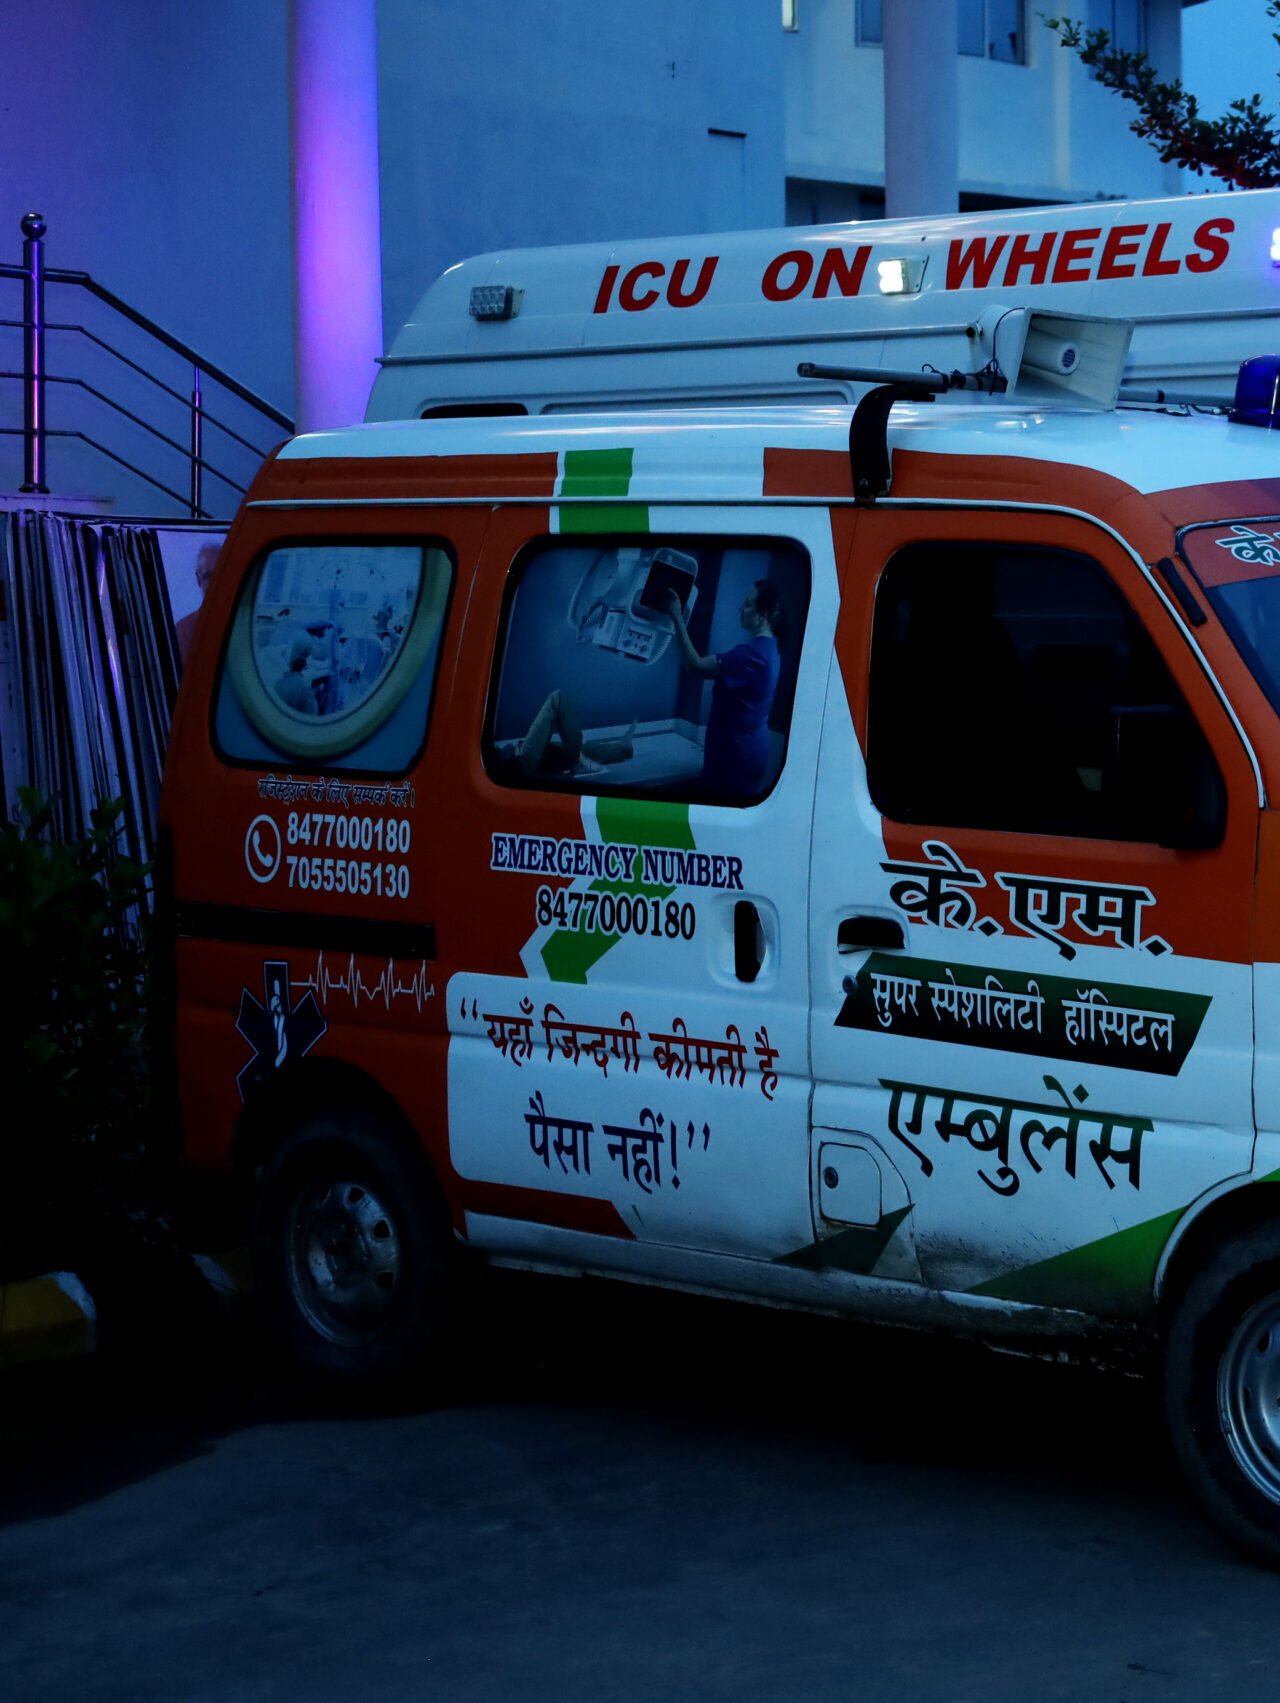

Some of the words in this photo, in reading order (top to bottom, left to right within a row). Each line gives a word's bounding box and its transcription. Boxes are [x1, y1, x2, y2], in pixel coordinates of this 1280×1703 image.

[594, 256, 720, 314] ICU
[760, 246, 872, 301] ON
[944, 217, 1234, 290] WHEELS
[312, 777, 326, 803] के
[327, 777, 352, 810] लिए
[286, 811, 411, 854] 8477000180
[491, 833, 636, 886] EMERGENCY
[643, 850, 744, 890] NUMBER
[286, 855, 410, 899] 7055505130
[537, 888, 696, 940] 8477000180
[870, 971, 921, 1028] सुपर
[927, 967, 1047, 1034] स्पेशलिटी
[1061, 987, 1176, 1053] हॉस्पिटल
[648, 1016, 747, 1088] कीमती
[754, 1026, 780, 1100] है
[524, 1090, 594, 1174] पैसा
[878, 1075, 1155, 1196] एम्बुलेंस
